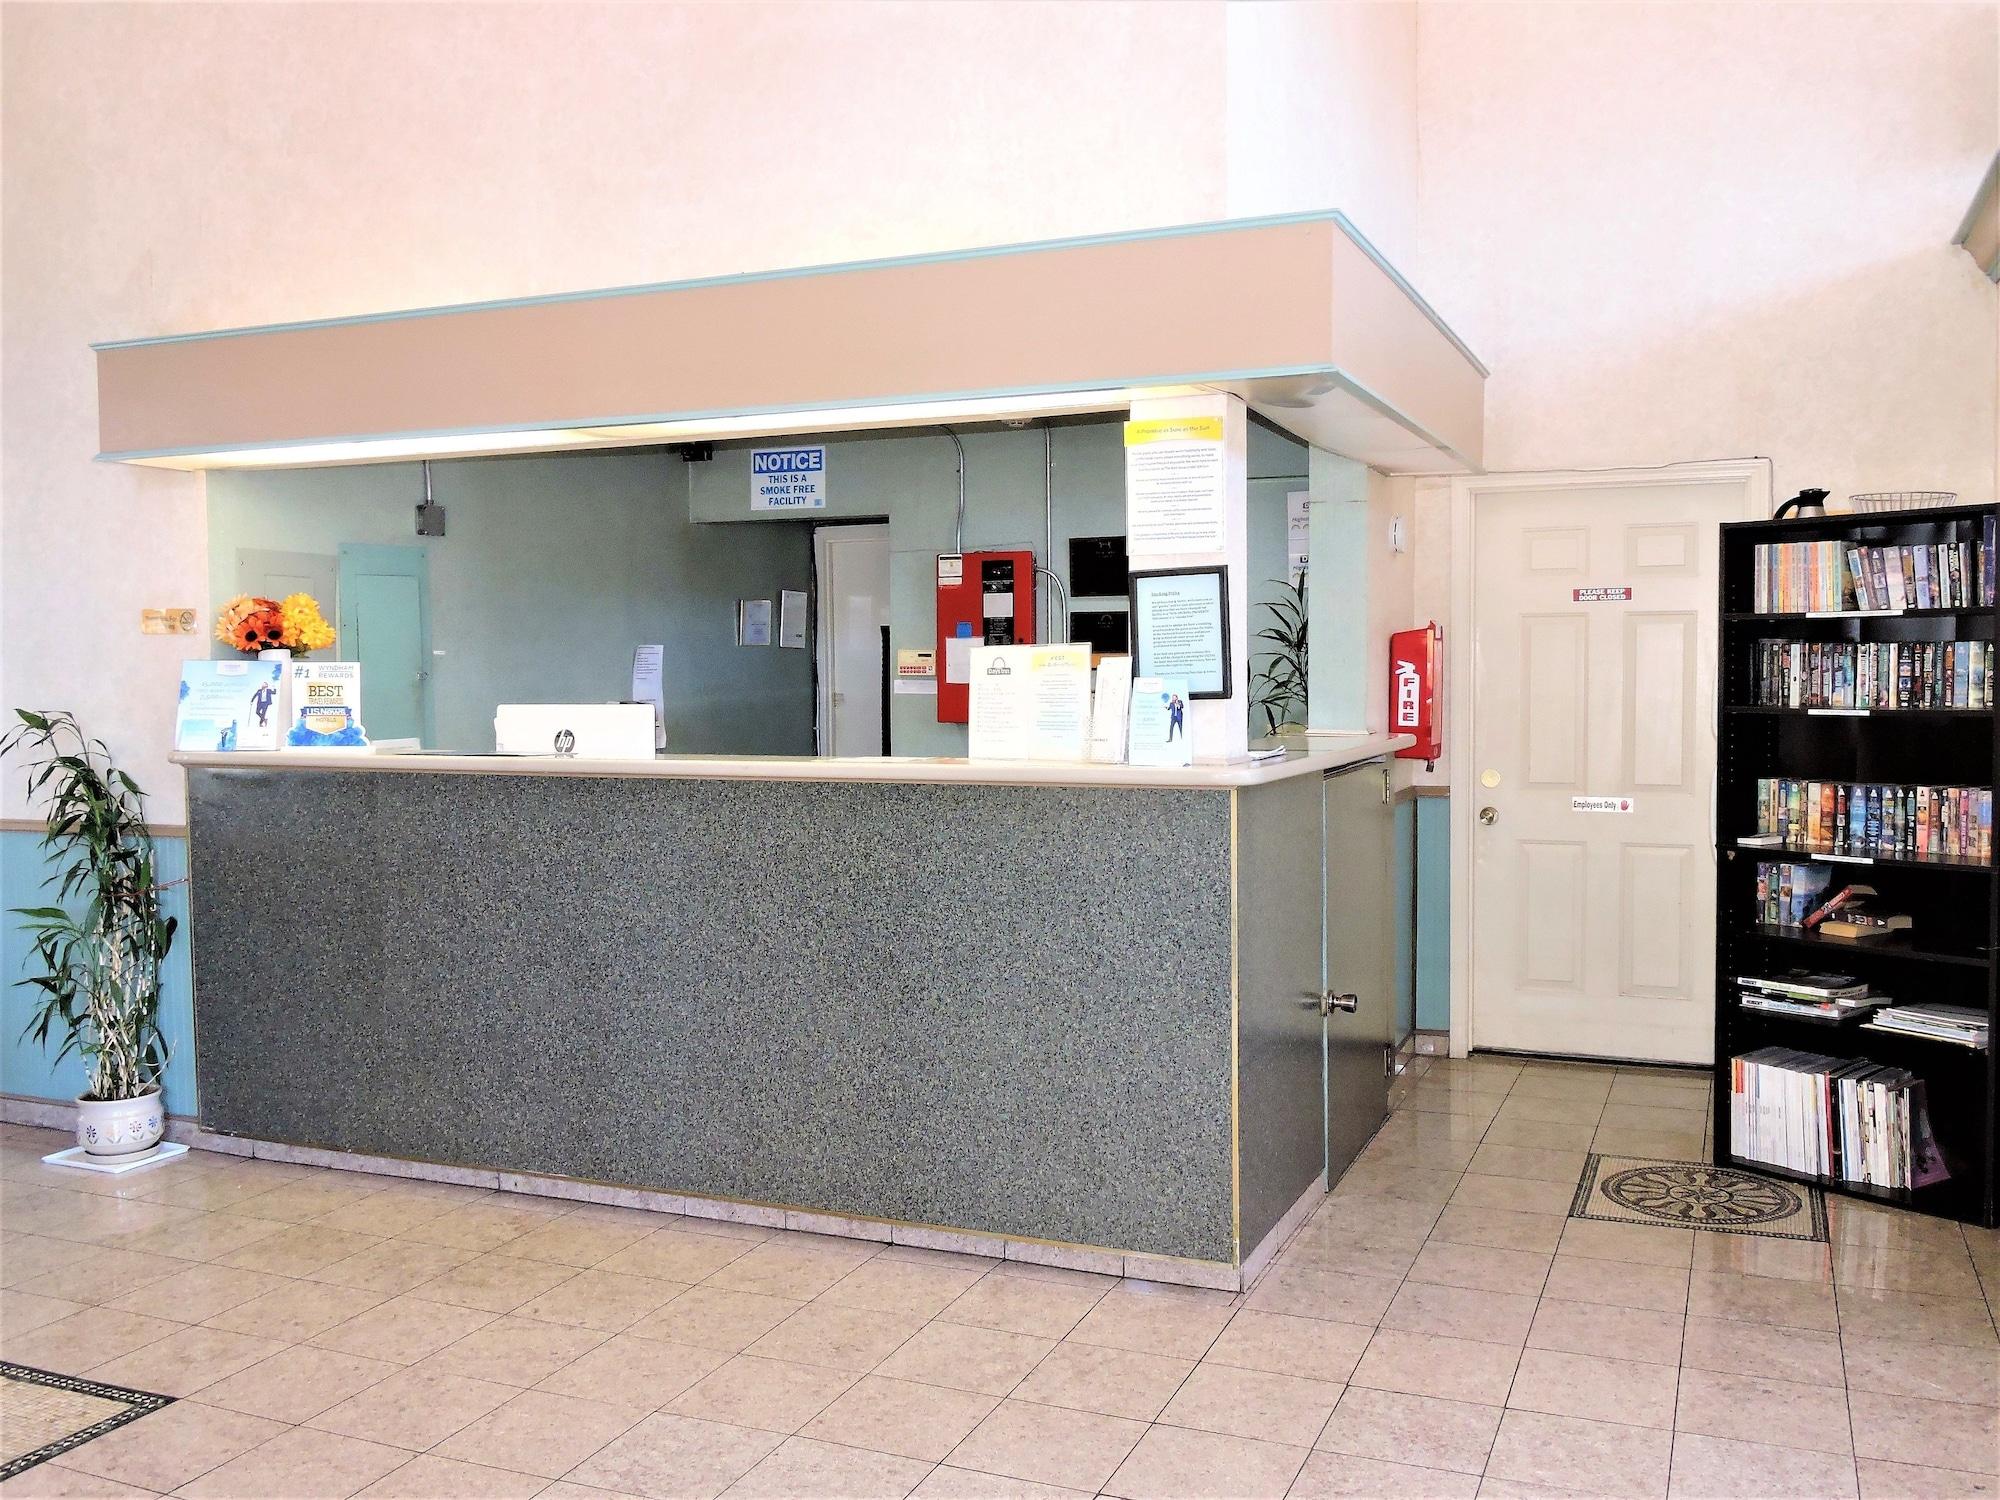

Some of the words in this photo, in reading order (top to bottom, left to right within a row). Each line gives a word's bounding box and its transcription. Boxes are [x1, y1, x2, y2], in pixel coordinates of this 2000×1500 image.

[755, 453, 821, 471] NOTICE
[768, 475, 788, 483] THIS
[790, 474, 799, 483] IS
[760, 486, 790, 494] SMOKE
[793, 485, 815, 493] FREE
[768, 496, 807, 505] FACILITY
[294, 665, 310, 678] #1
[308, 685, 343, 697] BEST
[1403, 677, 1415, 722] FIRE
[555, 729, 575, 753] hp
[1573, 801, 1602, 809] Employees
[1604, 801, 1616, 810] Only
